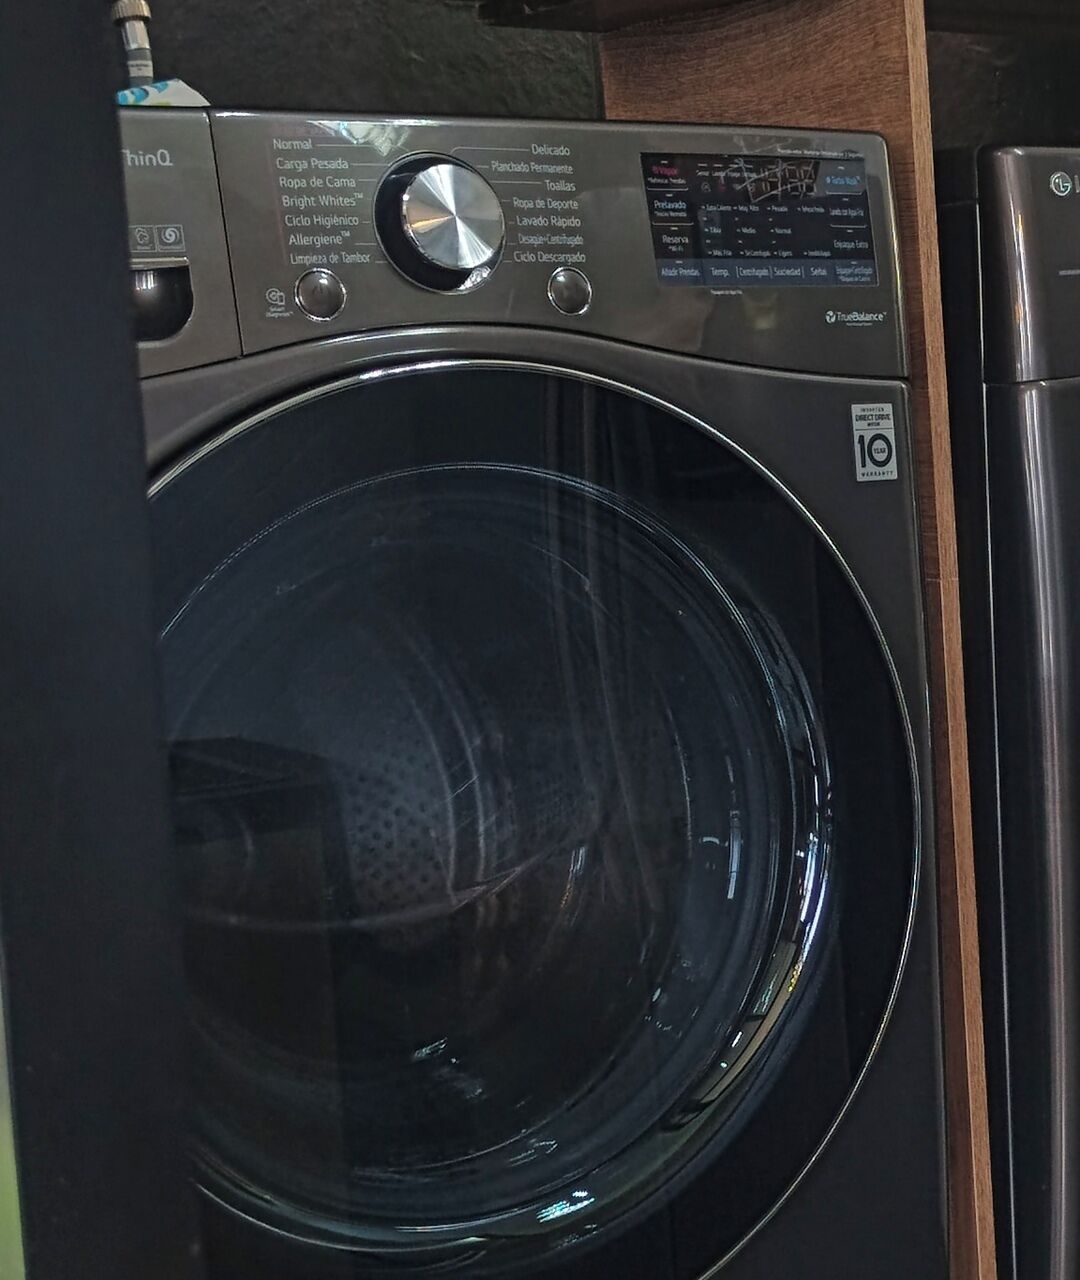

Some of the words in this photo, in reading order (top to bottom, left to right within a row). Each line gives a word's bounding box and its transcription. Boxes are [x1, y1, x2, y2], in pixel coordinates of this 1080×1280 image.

[273, 138, 312, 150] Normal
[531, 143, 570, 156] Delicado
[276, 157, 308, 172] Carga
[311, 157, 349, 169] Pesada
[491, 160, 530, 173] Planchado
[530, 161, 574, 174] Permanente
[279, 176, 307, 189] Ropa
[310, 176, 323, 187] de
[325, 176, 356, 187] Cama
[544, 179, 576, 192] Toallas
[282, 195, 316, 209] Bright
[512, 197, 533, 210] Ropa
[536, 198, 545, 209] de
[547, 198, 579, 211] Deporte
[285, 215, 311, 226] Ciclo
[516, 215, 548, 226] Lavado
[290, 253, 327, 266] Limpieza
[329, 253, 339, 264] de
[341, 252, 370, 263] Tambor
[513, 251, 536, 263] Ciclo
[537, 251, 586, 265] Descargado
[855, 413, 874, 421] DIRECT
[875, 413, 891, 421] DRIVE
[858, 433, 893, 468] 10
